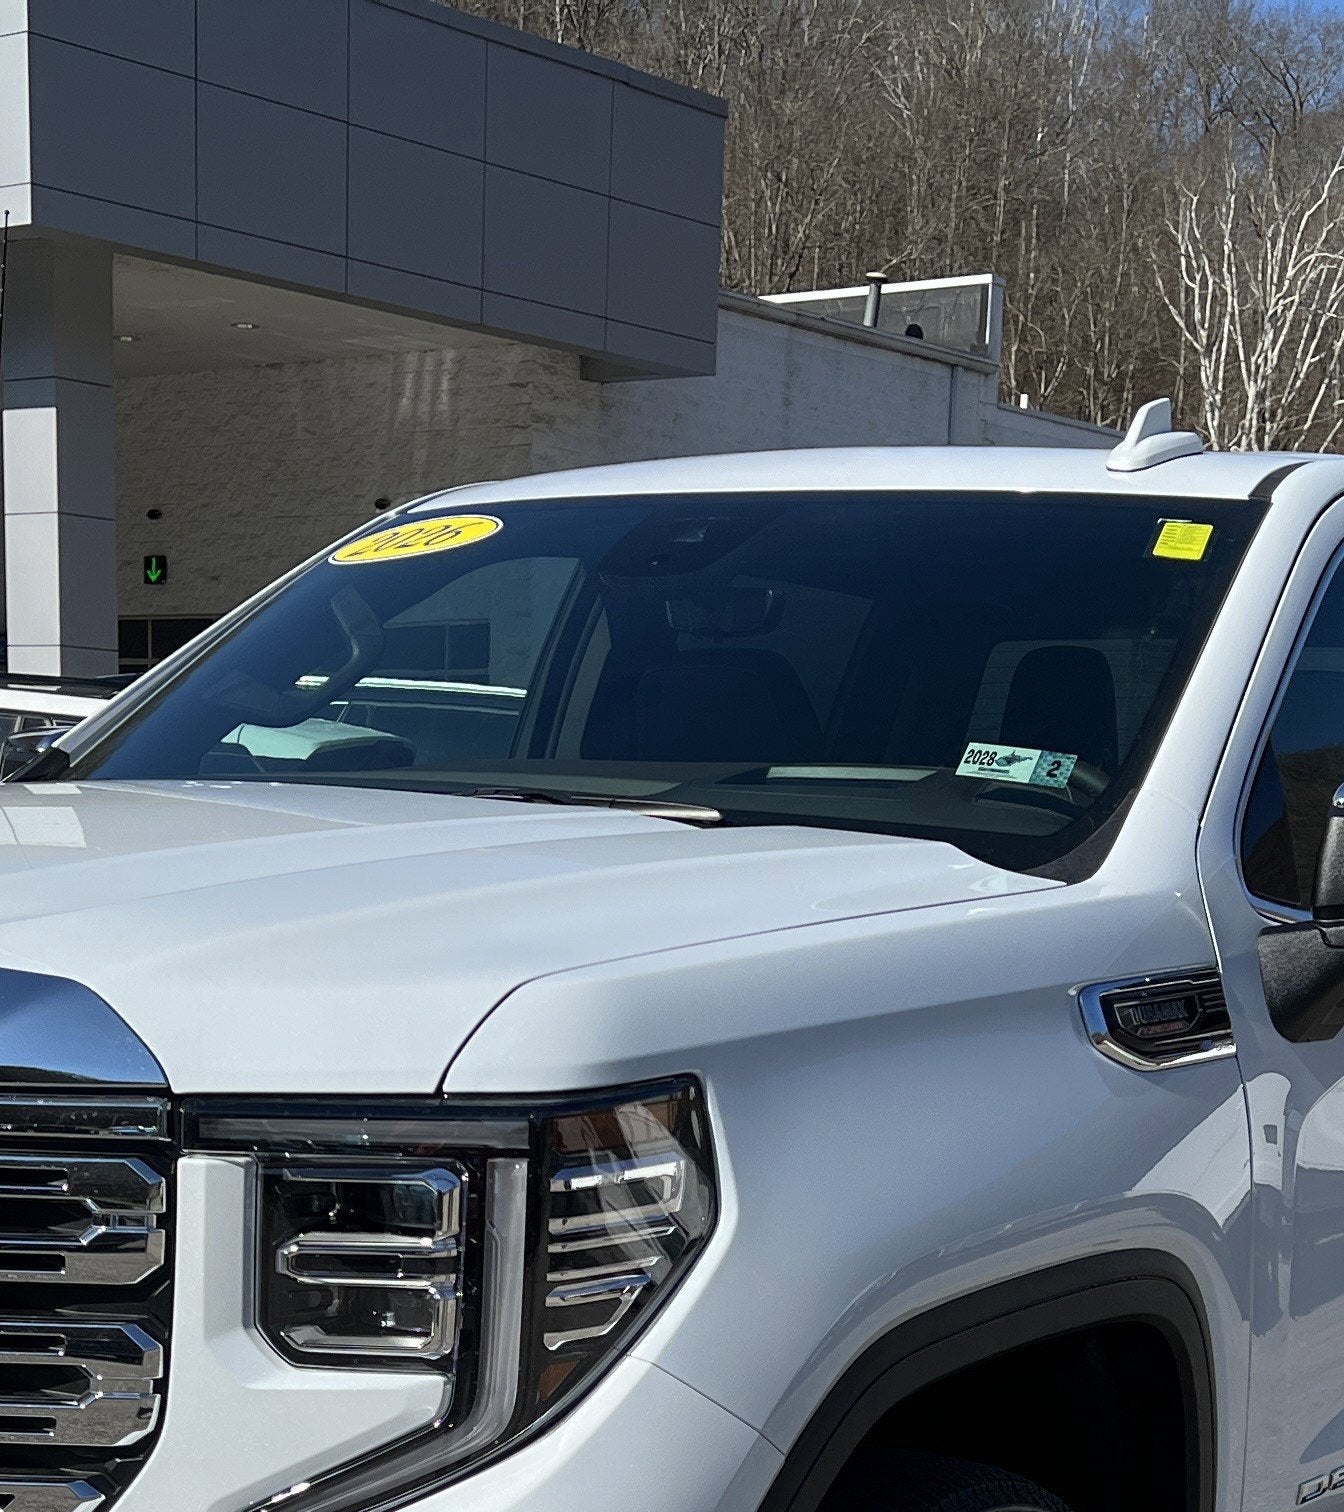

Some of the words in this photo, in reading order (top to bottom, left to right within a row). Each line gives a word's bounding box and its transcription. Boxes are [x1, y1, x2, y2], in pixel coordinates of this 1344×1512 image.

[343, 521, 485, 558] 2026
[963, 748, 998, 767] 2028
[1045, 760, 1062, 778] 2
